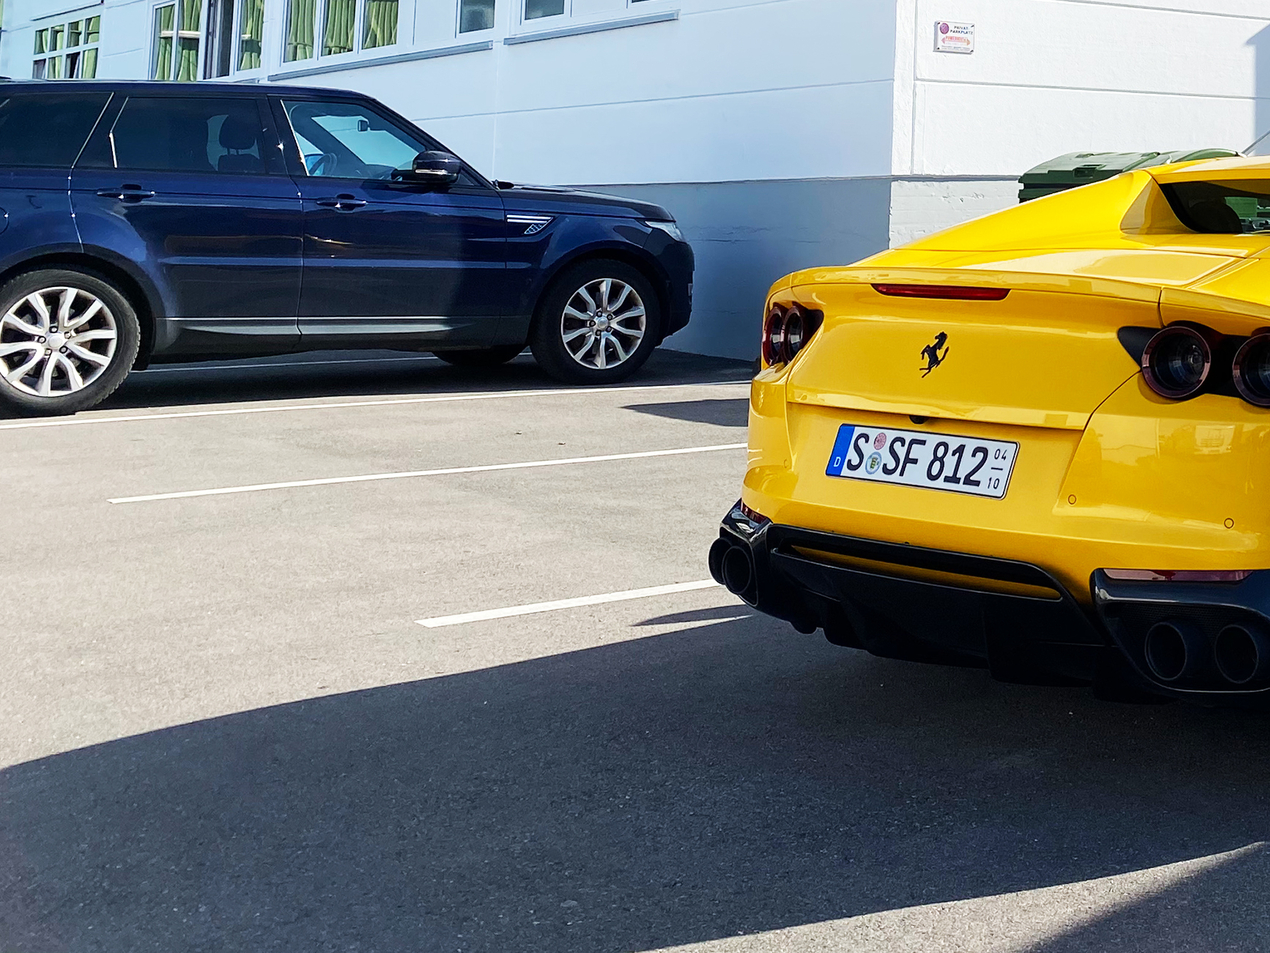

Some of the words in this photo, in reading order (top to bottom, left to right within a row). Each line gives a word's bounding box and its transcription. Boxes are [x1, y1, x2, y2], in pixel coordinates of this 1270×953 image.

[846, 432, 870, 472] S
[881, 436, 927, 477] SF
[926, 441, 989, 488] 812
[994, 448, 1007, 461] 04
[833, 456, 841, 468] D
[987, 477, 1000, 490] 10
